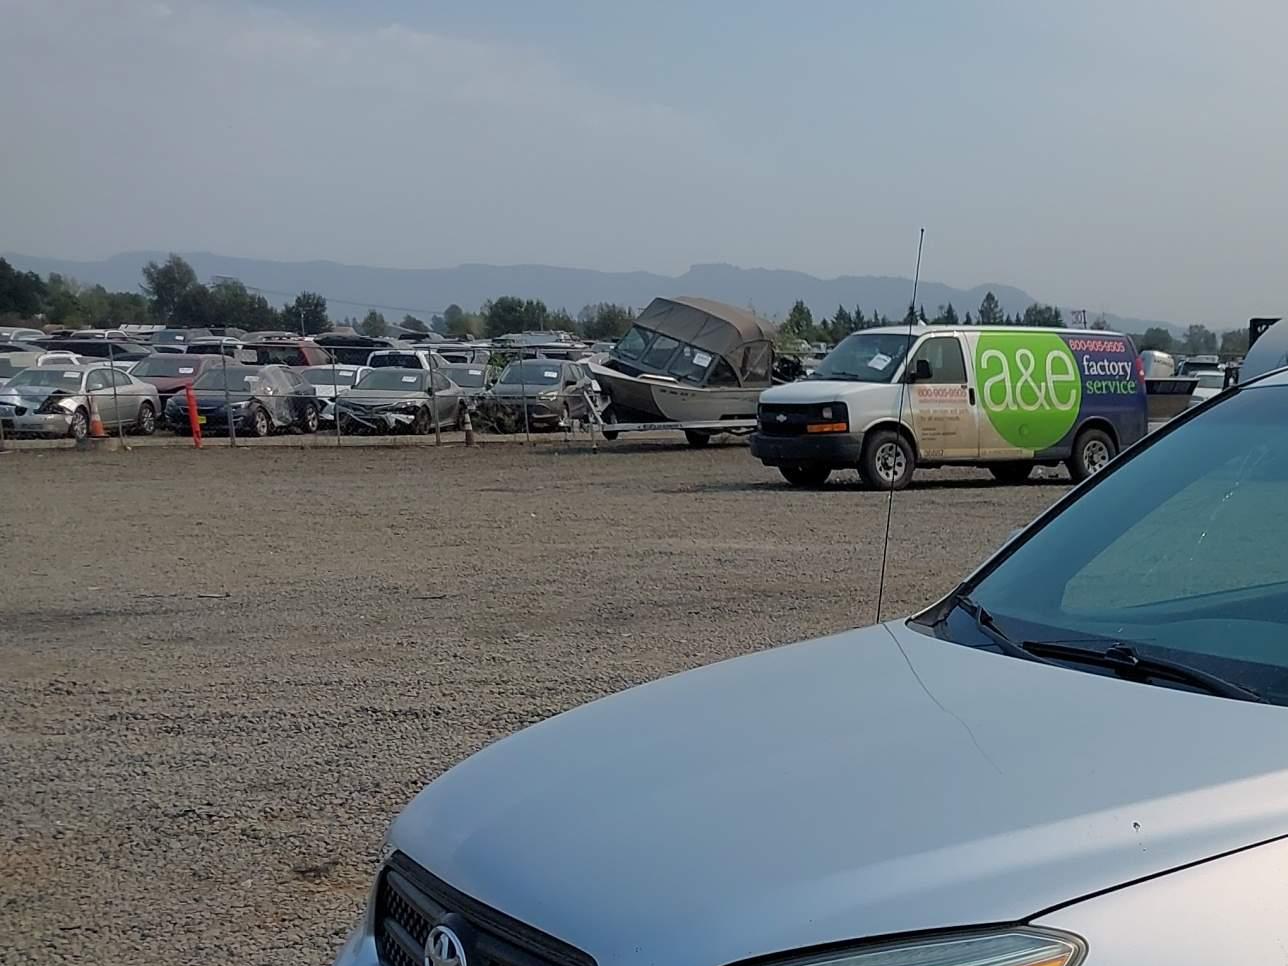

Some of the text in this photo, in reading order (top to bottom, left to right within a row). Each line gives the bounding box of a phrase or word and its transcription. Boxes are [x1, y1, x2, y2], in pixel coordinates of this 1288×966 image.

[981, 348, 1077, 412] a&e
[1083, 354, 1132, 381] factory
[1086, 376, 1137, 394] service
